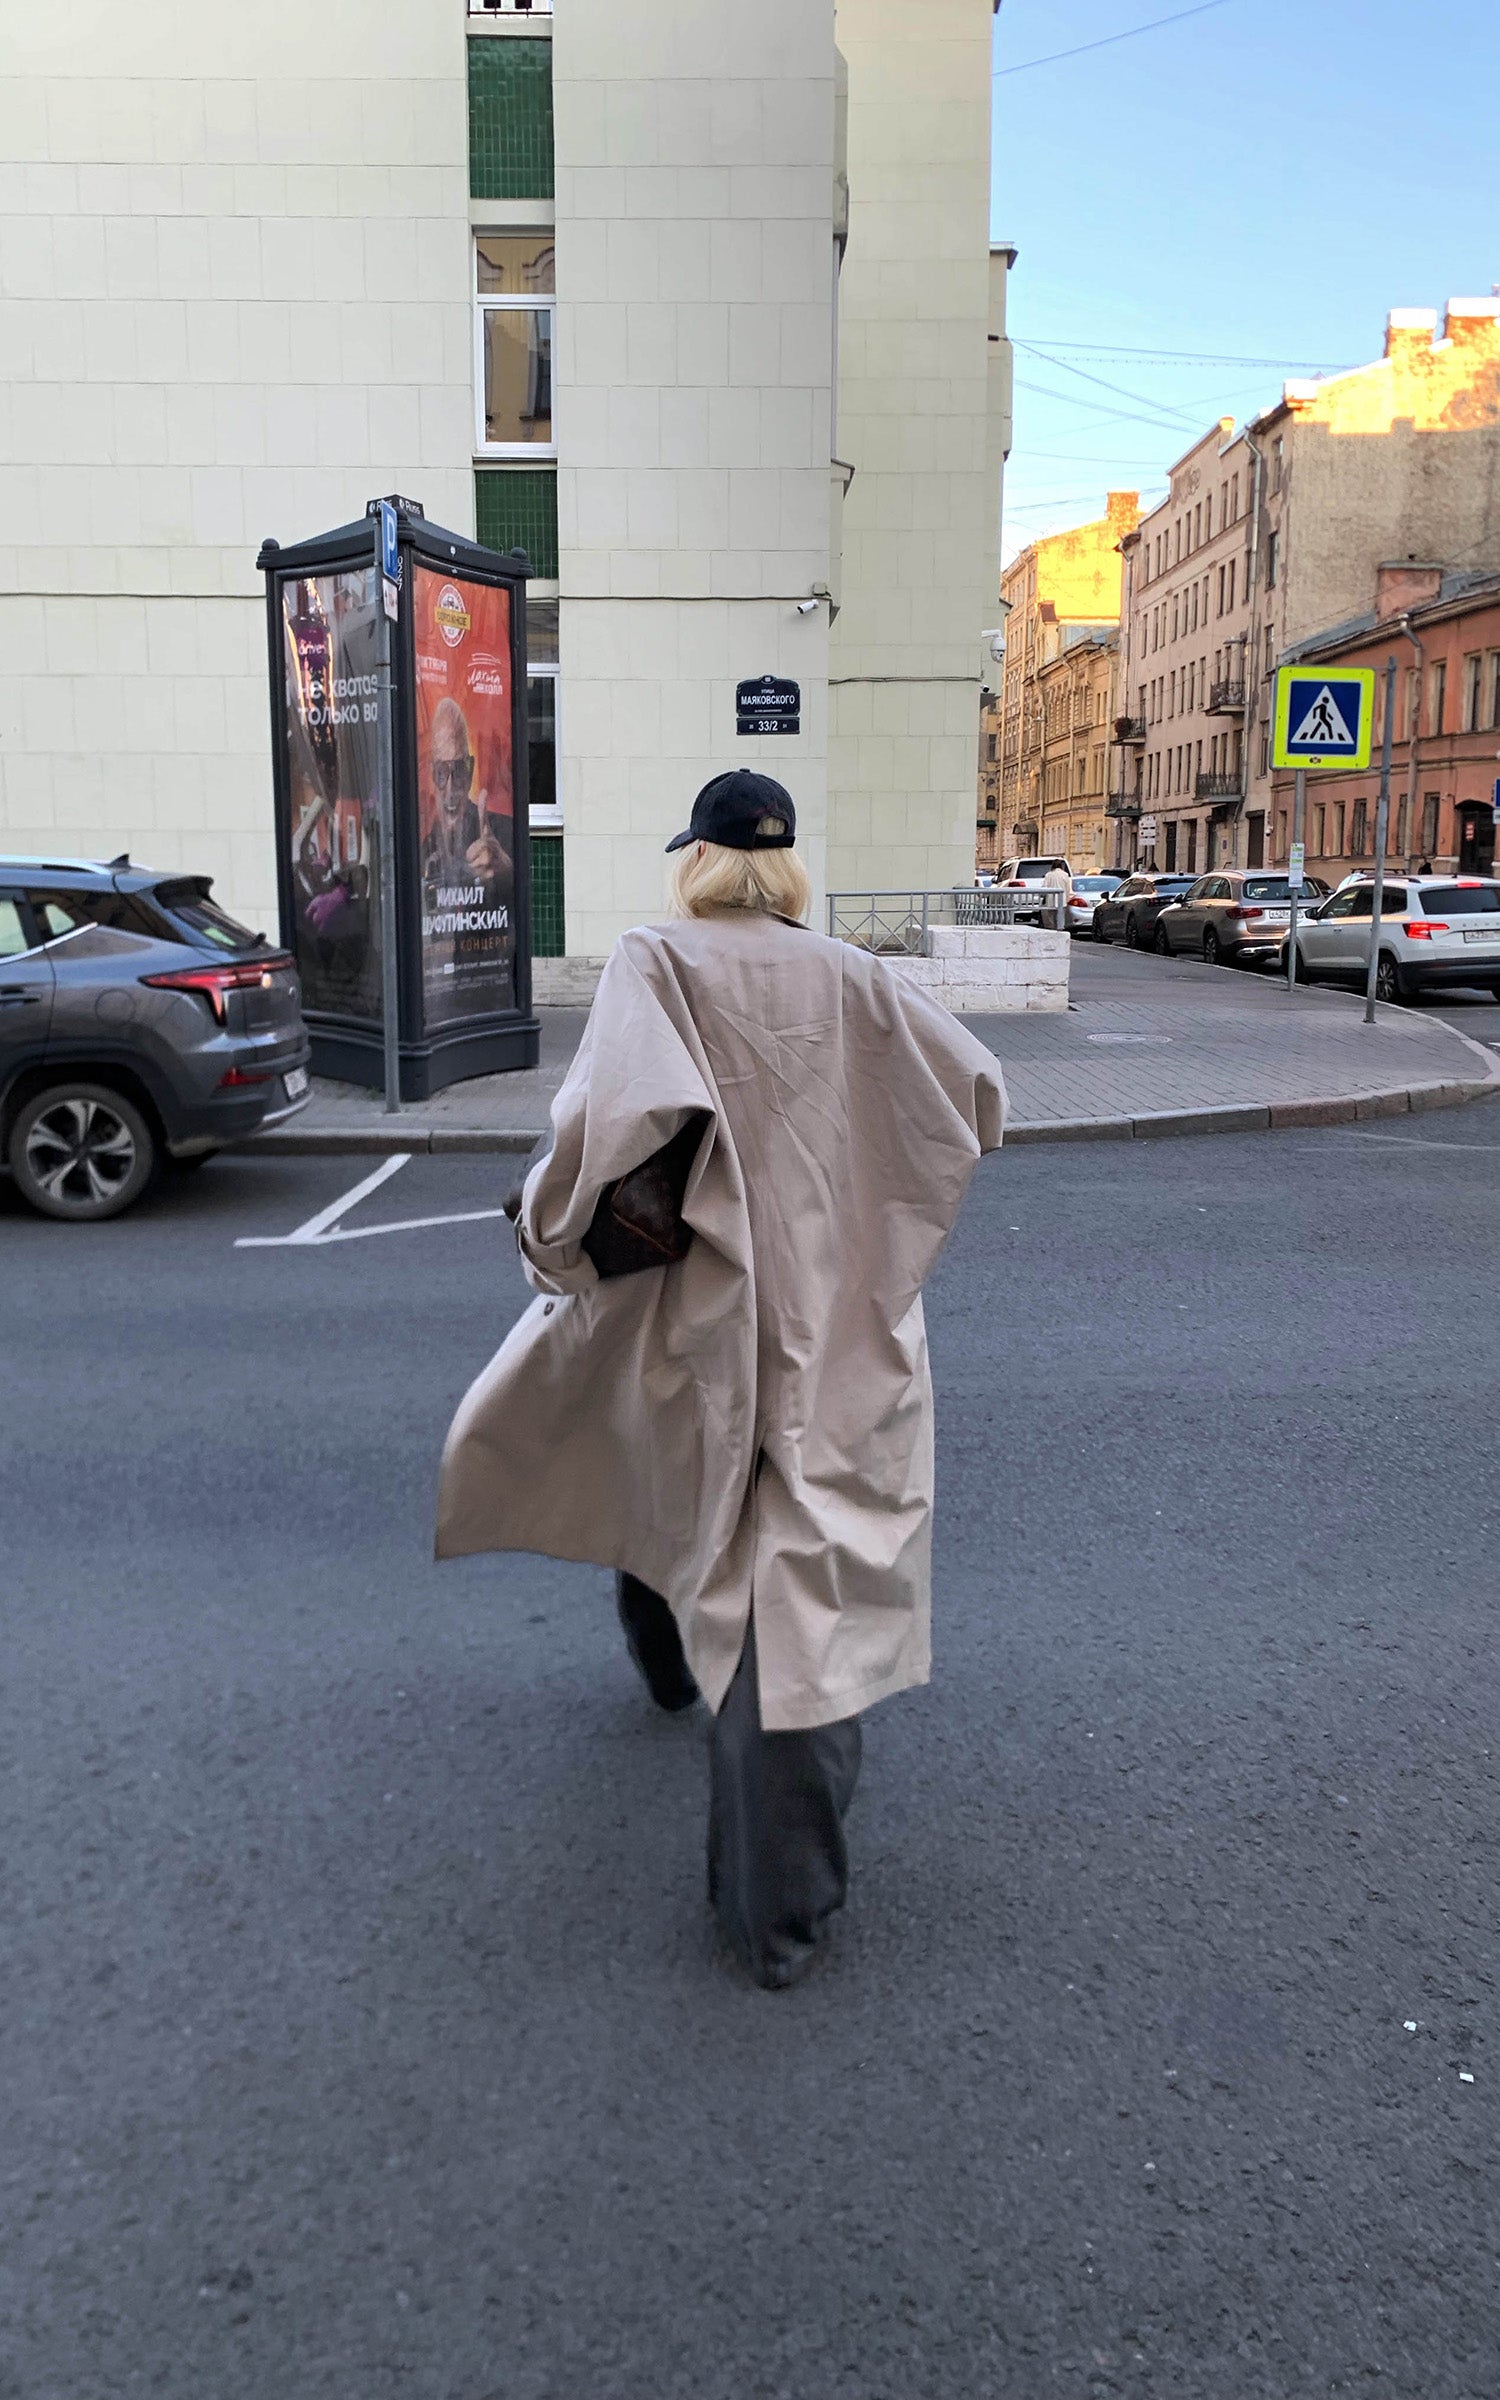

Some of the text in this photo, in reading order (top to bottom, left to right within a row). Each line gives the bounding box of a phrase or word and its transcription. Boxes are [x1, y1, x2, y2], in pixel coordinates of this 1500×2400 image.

[328, 674, 378, 698] хватае
[741, 695, 795, 705] МАЯКОВСКОГО
[298, 702, 378, 727] только ва
[758, 720, 778, 732] 33/2
[436, 885, 485, 908] МИХАИЛ
[421, 905, 509, 936] ШУФУТИНСКИЙ
[460, 935, 509, 953] КОНЦЕРТ
